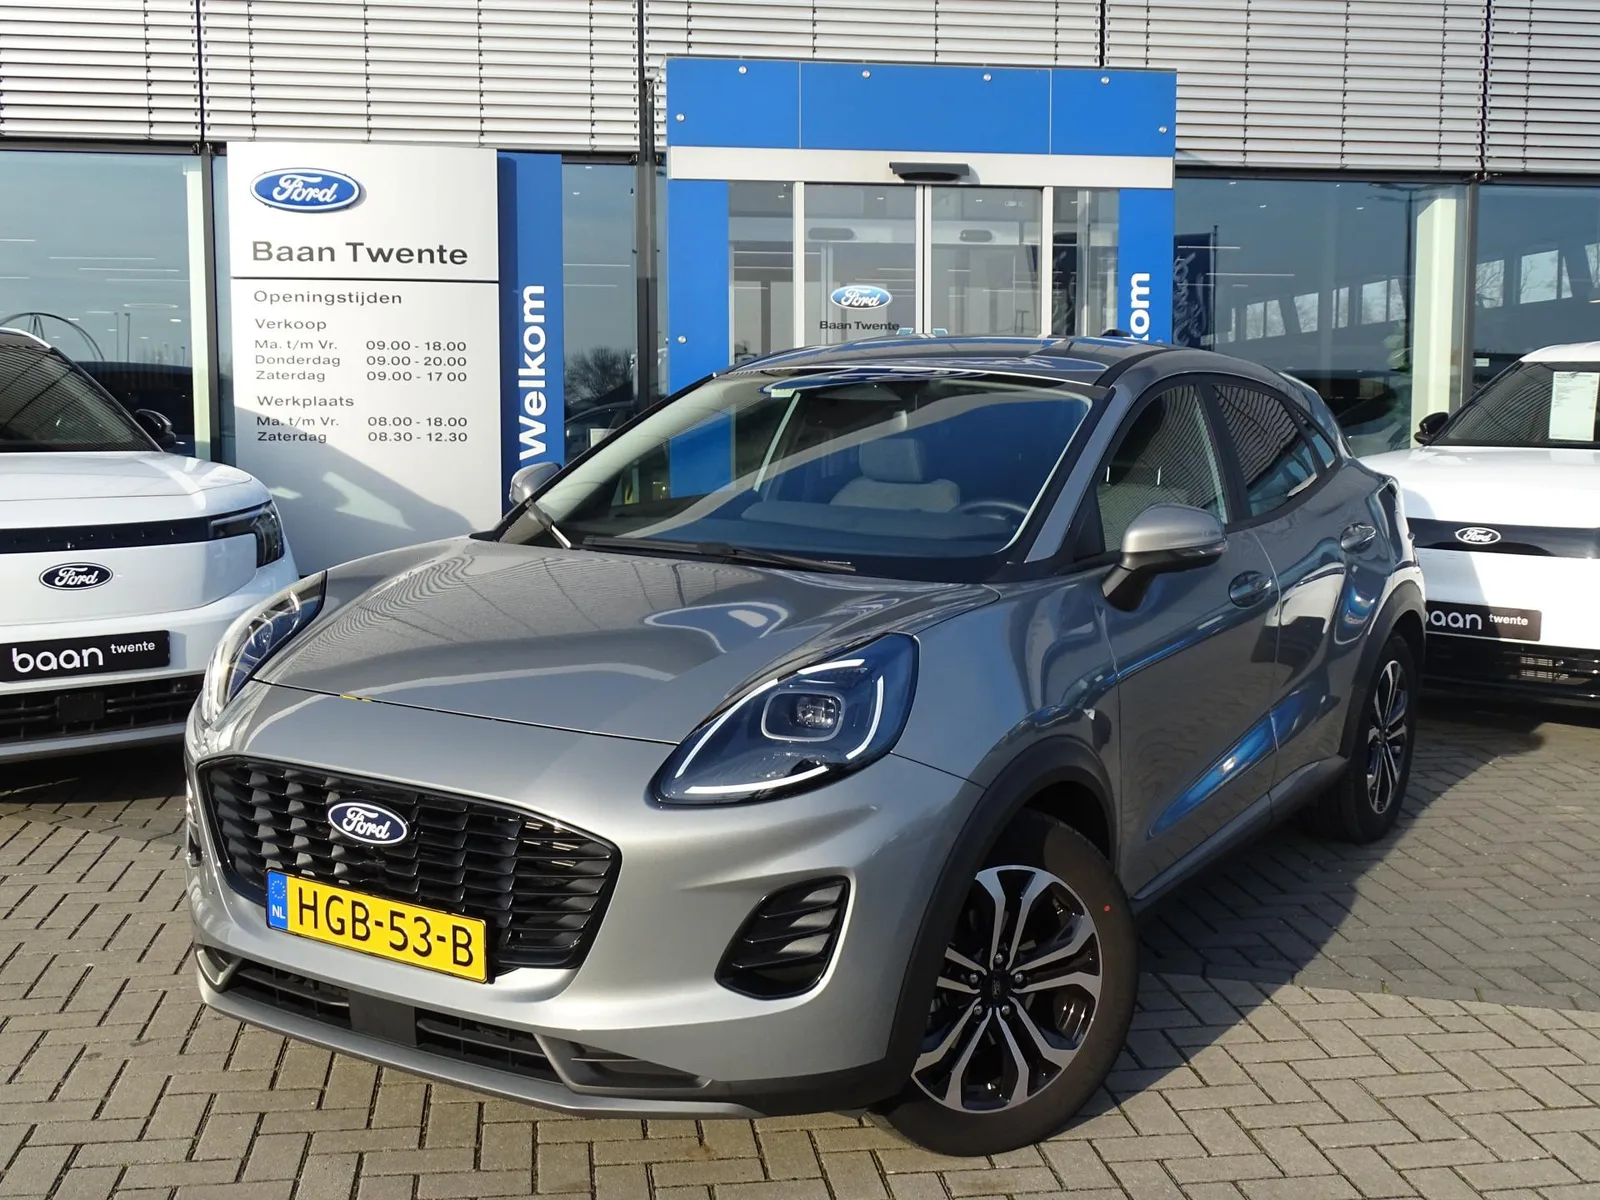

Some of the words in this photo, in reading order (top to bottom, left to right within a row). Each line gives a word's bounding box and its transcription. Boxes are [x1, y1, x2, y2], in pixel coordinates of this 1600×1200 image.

[273, 174, 338, 203] Ford
[252, 240, 336, 262] Baan
[345, 242, 468, 266] Twente
[253, 290, 402, 307] Openingstijden
[841, 288, 881, 307] Ford
[1130, 272, 1150, 341] om
[254, 318, 327, 332] Verkoop
[819, 320, 852, 331] Baan
[854, 321, 900, 332] Twente
[254, 339, 282, 350] Ma.
[286, 339, 314, 351] t/m
[318, 339, 338, 350] Vr.
[365, 340, 411, 351] 09.00
[424, 341, 467, 352] 18.00
[255, 354, 341, 367] Donderdag
[366, 355, 411, 366] 09.00
[423, 356, 467, 367] 20.00
[256, 370, 326, 383] Zaterdag
[366, 370, 413, 382] 09.00
[519, 285, 547, 460] Welkom
[256, 395, 355, 408] Werkplaats
[256, 416, 285, 427] Ma.
[287, 416, 316, 428] t/m
[319, 416, 339, 427] Vr.
[367, 416, 413, 427] 08.00
[426, 416, 468, 427] 18.00
[256, 431, 327, 444] Zaterdag
[367, 431, 413, 442] 08.30
[426, 431, 468, 442] 12.30
[1463, 529, 1492, 542] Ford
[54, 567, 99, 586] Ford
[1488, 614, 1529, 626] twente
[12, 648, 104, 673] baan
[110, 640, 156, 654] twente
[341, 807, 391, 840] Ford
[271, 904, 287, 920] NL
[297, 887, 474, 967] HGB-53-B
